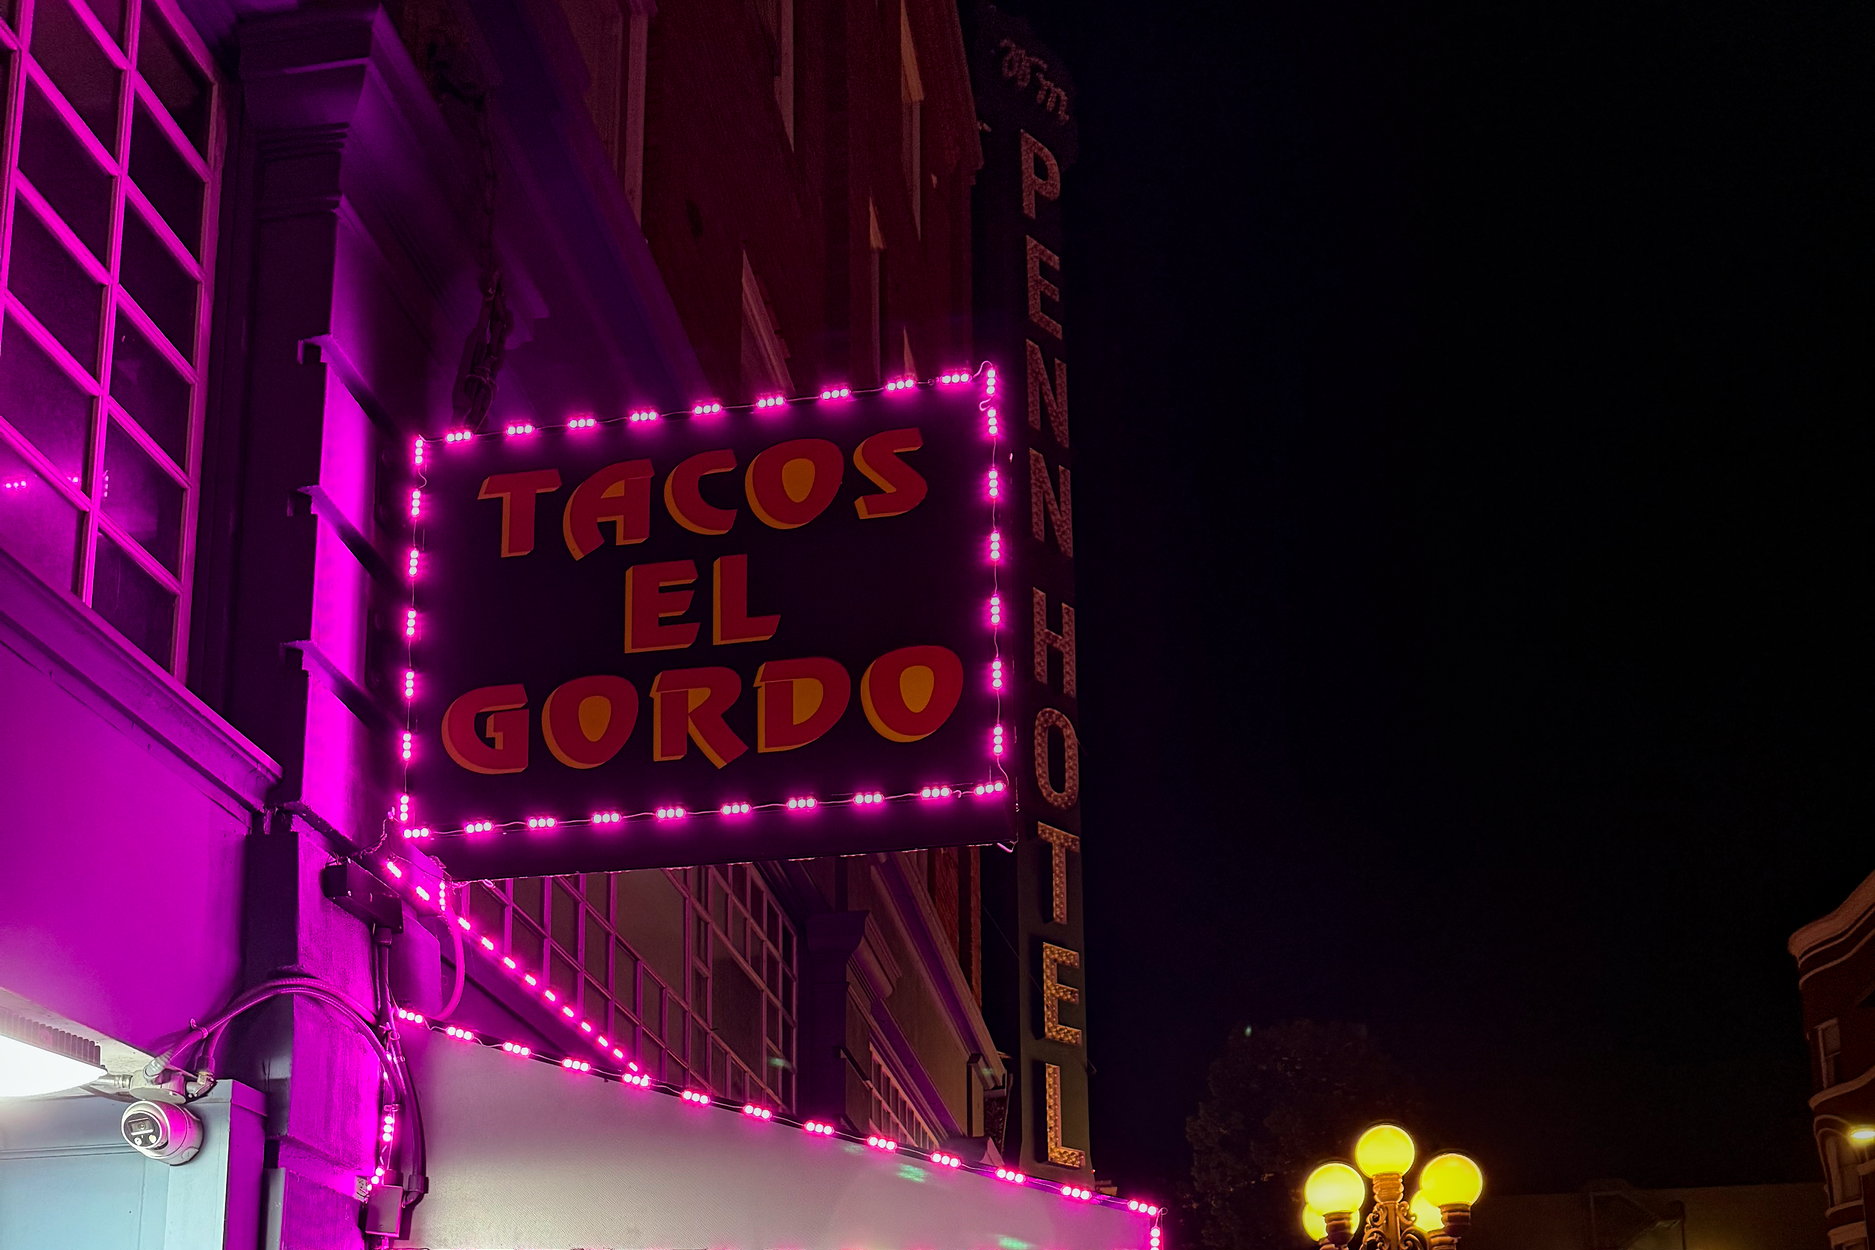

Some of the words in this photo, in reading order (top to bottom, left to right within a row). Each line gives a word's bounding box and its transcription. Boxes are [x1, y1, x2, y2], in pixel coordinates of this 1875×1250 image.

[1020, 128, 1074, 558] PENN
[477, 427, 929, 561] TACOS
[624, 553, 782, 654] EL
[441, 644, 965, 775] GORDO
[1032, 586, 1086, 1169] HOTEL
